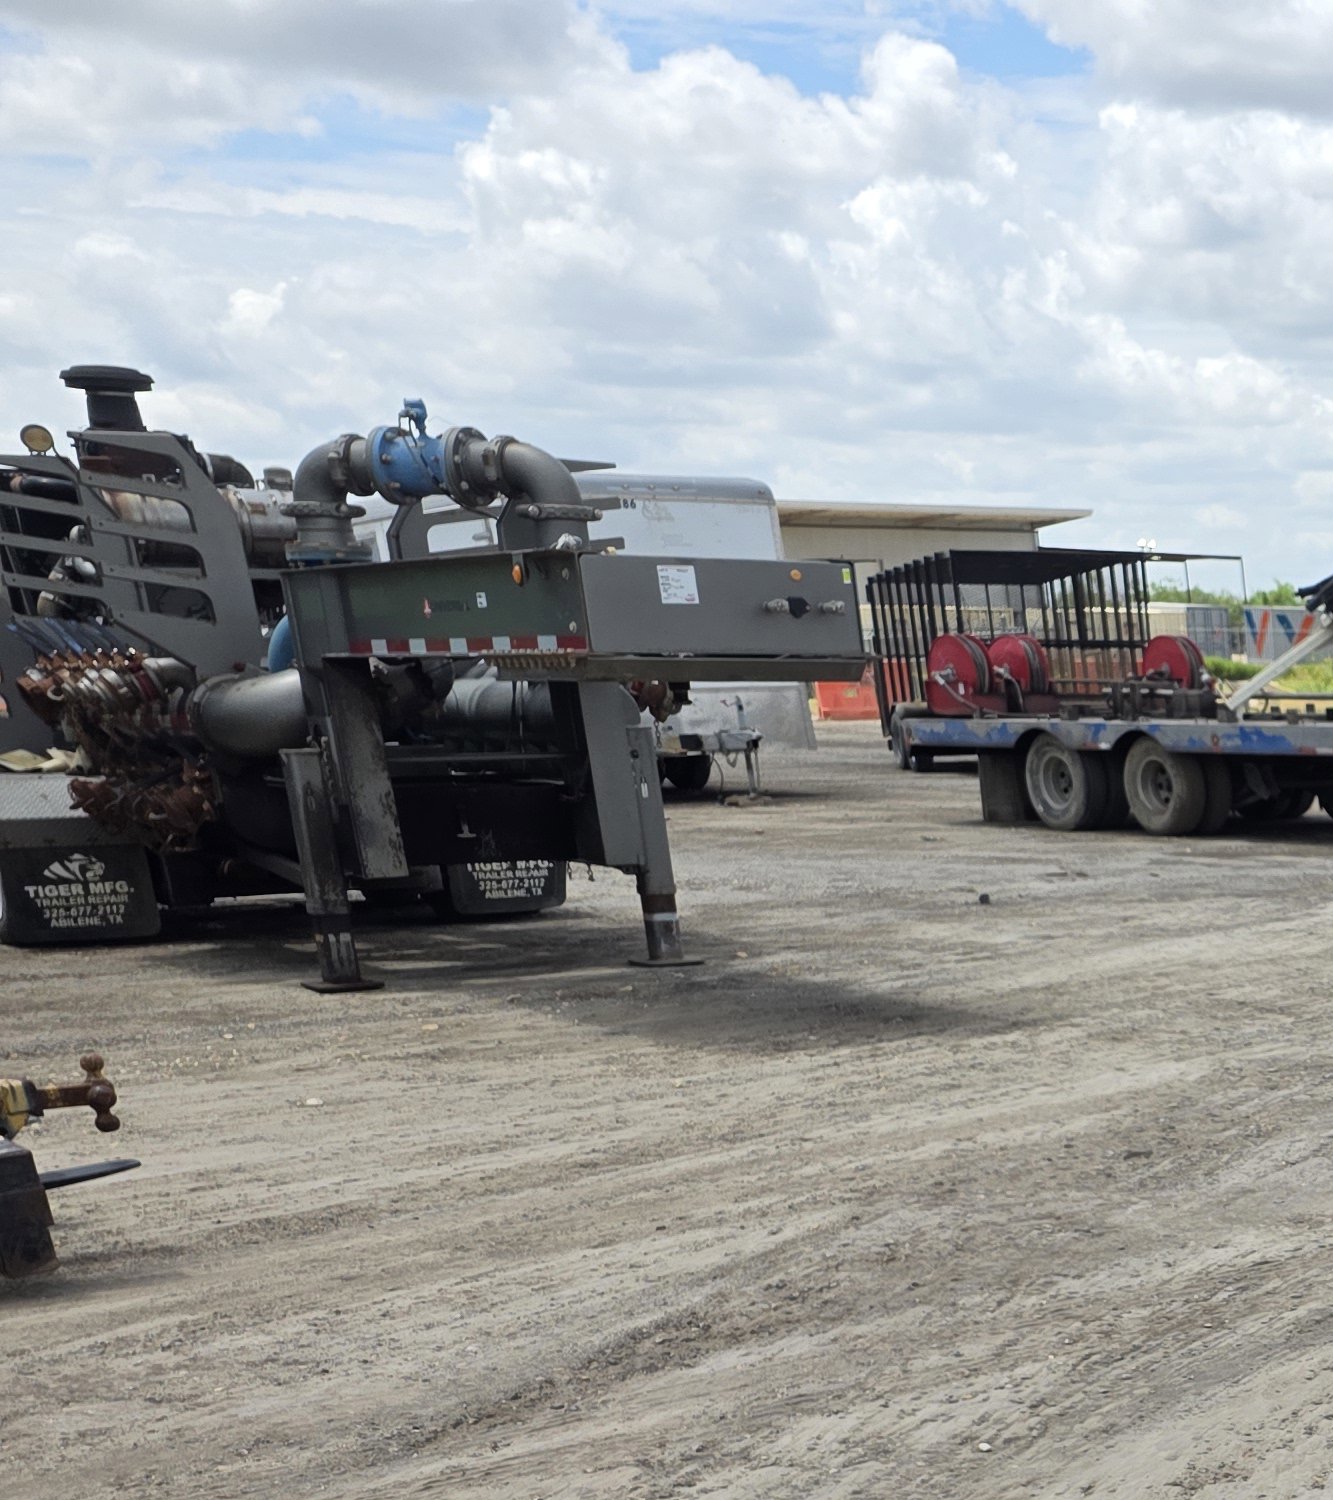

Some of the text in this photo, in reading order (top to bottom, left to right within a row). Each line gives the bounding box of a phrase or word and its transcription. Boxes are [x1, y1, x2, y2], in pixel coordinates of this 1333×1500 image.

[472, 869, 549, 880] TRAILER REPAIR
[24, 881, 135, 898] TIGER MFG.
[532, 887, 543, 896] TX
[35, 894, 129, 907] TRAILER REPAIR
[108, 914, 124, 925] TX
